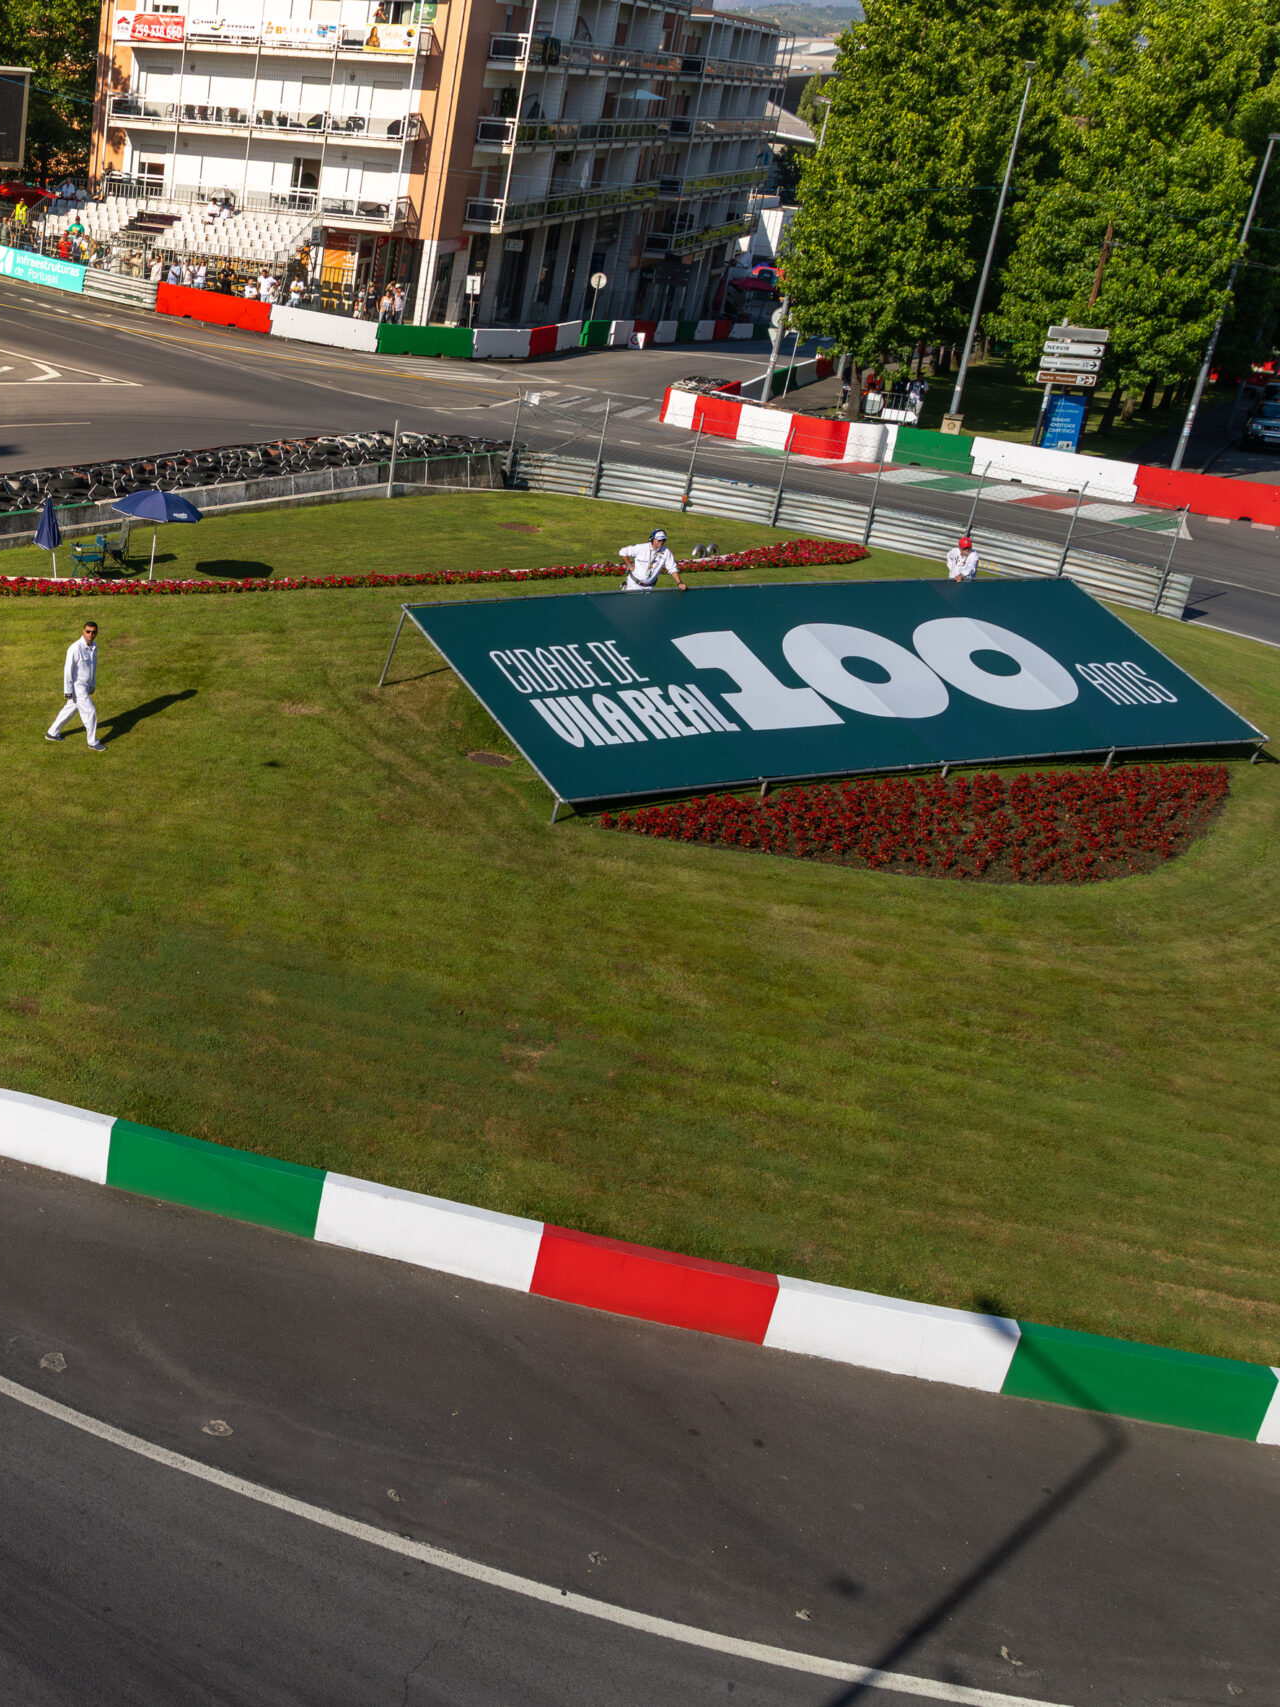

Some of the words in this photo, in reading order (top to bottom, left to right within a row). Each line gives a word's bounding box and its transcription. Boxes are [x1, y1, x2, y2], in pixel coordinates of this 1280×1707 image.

[14, 267, 24, 276] de
[27, 268, 58, 284] Portugal
[16, 253, 80, 277] Infraestruturas
[489, 644, 612, 694] CIDADE
[586, 640, 650, 684] DE
[671, 617, 1079, 730] 100
[1075, 660, 1178, 705] ANOS
[529, 693, 648, 748] VILA
[616, 684, 742, 739] REAL
